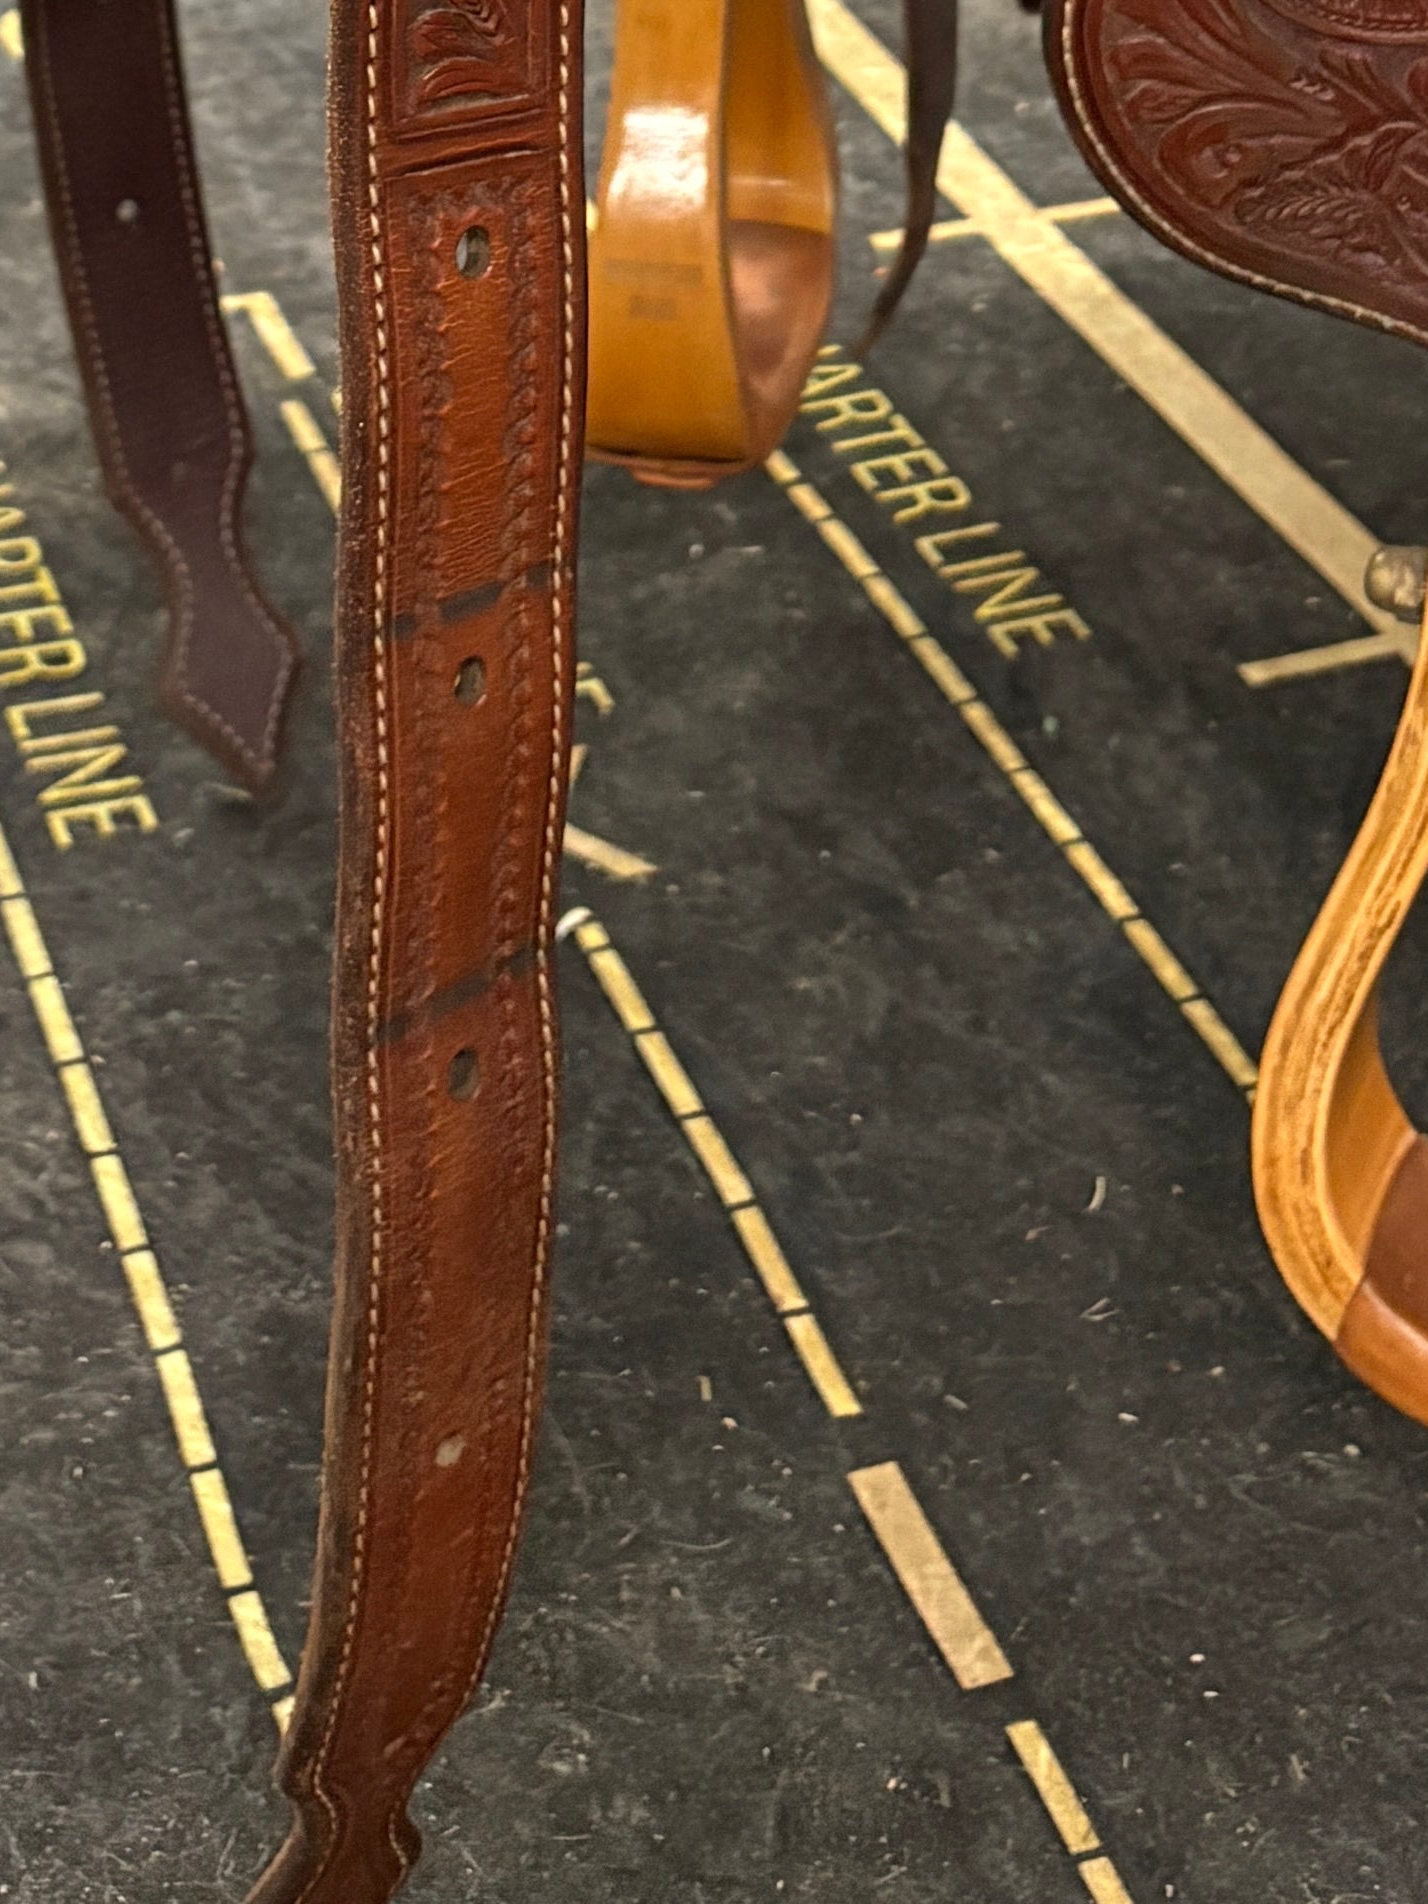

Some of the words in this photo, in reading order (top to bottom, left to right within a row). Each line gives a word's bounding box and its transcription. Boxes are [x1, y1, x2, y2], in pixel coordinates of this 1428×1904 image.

[800, 344, 972, 525] ARTER
[914, 521, 1094, 660] LINE
[3, 691, 160, 851] LINE
